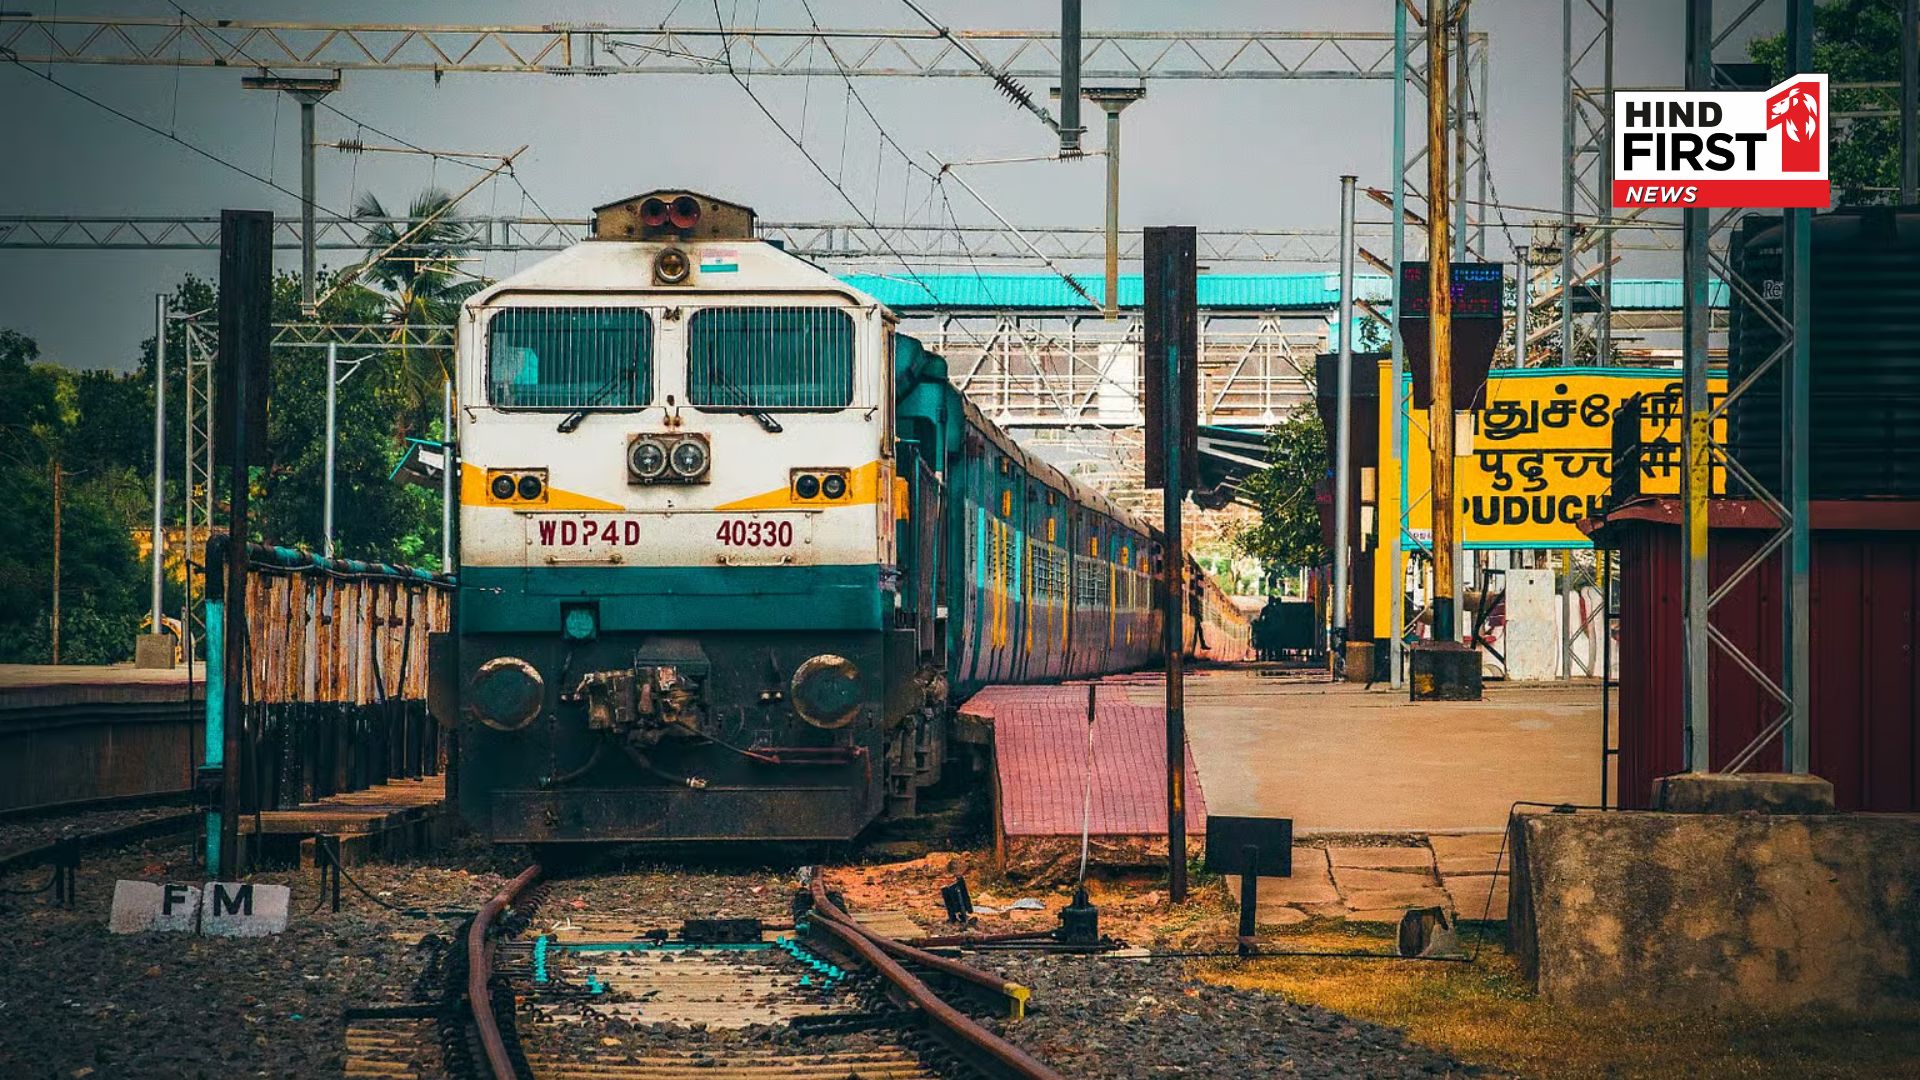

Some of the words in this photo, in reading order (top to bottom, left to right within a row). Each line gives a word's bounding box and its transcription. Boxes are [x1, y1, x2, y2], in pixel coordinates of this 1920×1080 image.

[1762, 279, 1785, 299] Re
[538, 519, 642, 547] WDP4D
[715, 519, 794, 547] 40330
